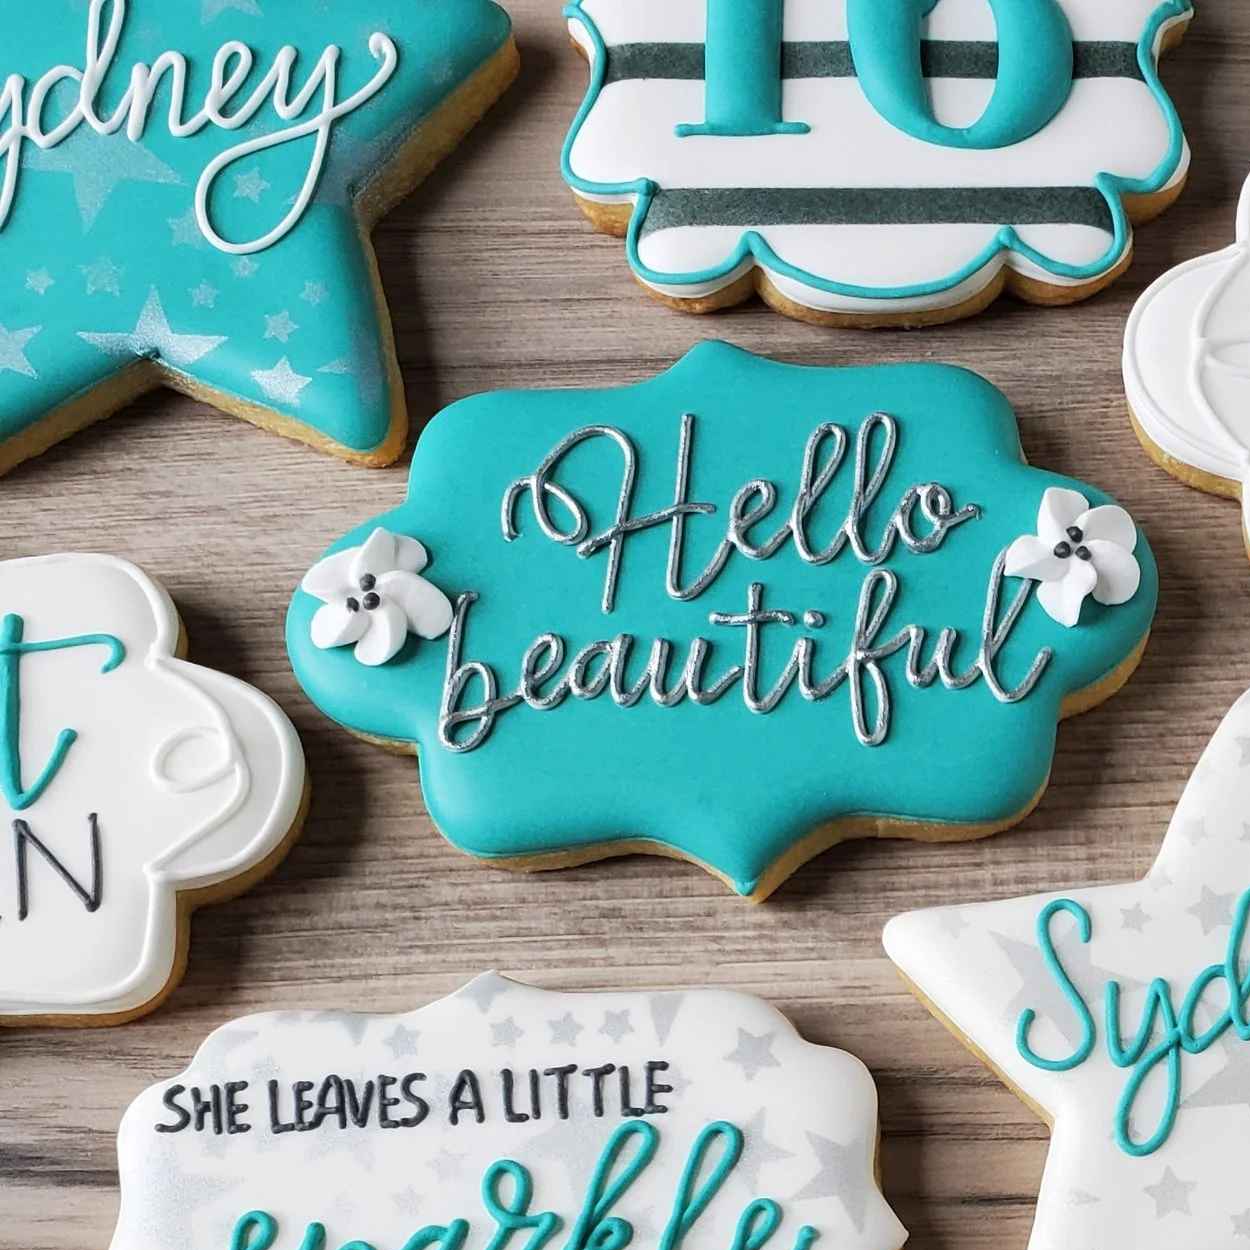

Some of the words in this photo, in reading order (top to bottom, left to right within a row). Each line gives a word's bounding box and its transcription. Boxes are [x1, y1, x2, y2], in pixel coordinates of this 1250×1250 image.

[502, 411, 982, 614] Hello
[439, 567, 1053, 753] beautiful
[155, 1080, 253, 1135] SHE
[268, 1072, 431, 1135] LEAVES
[448, 1069, 486, 1126] A
[500, 1060, 675, 1124] LITTLE
